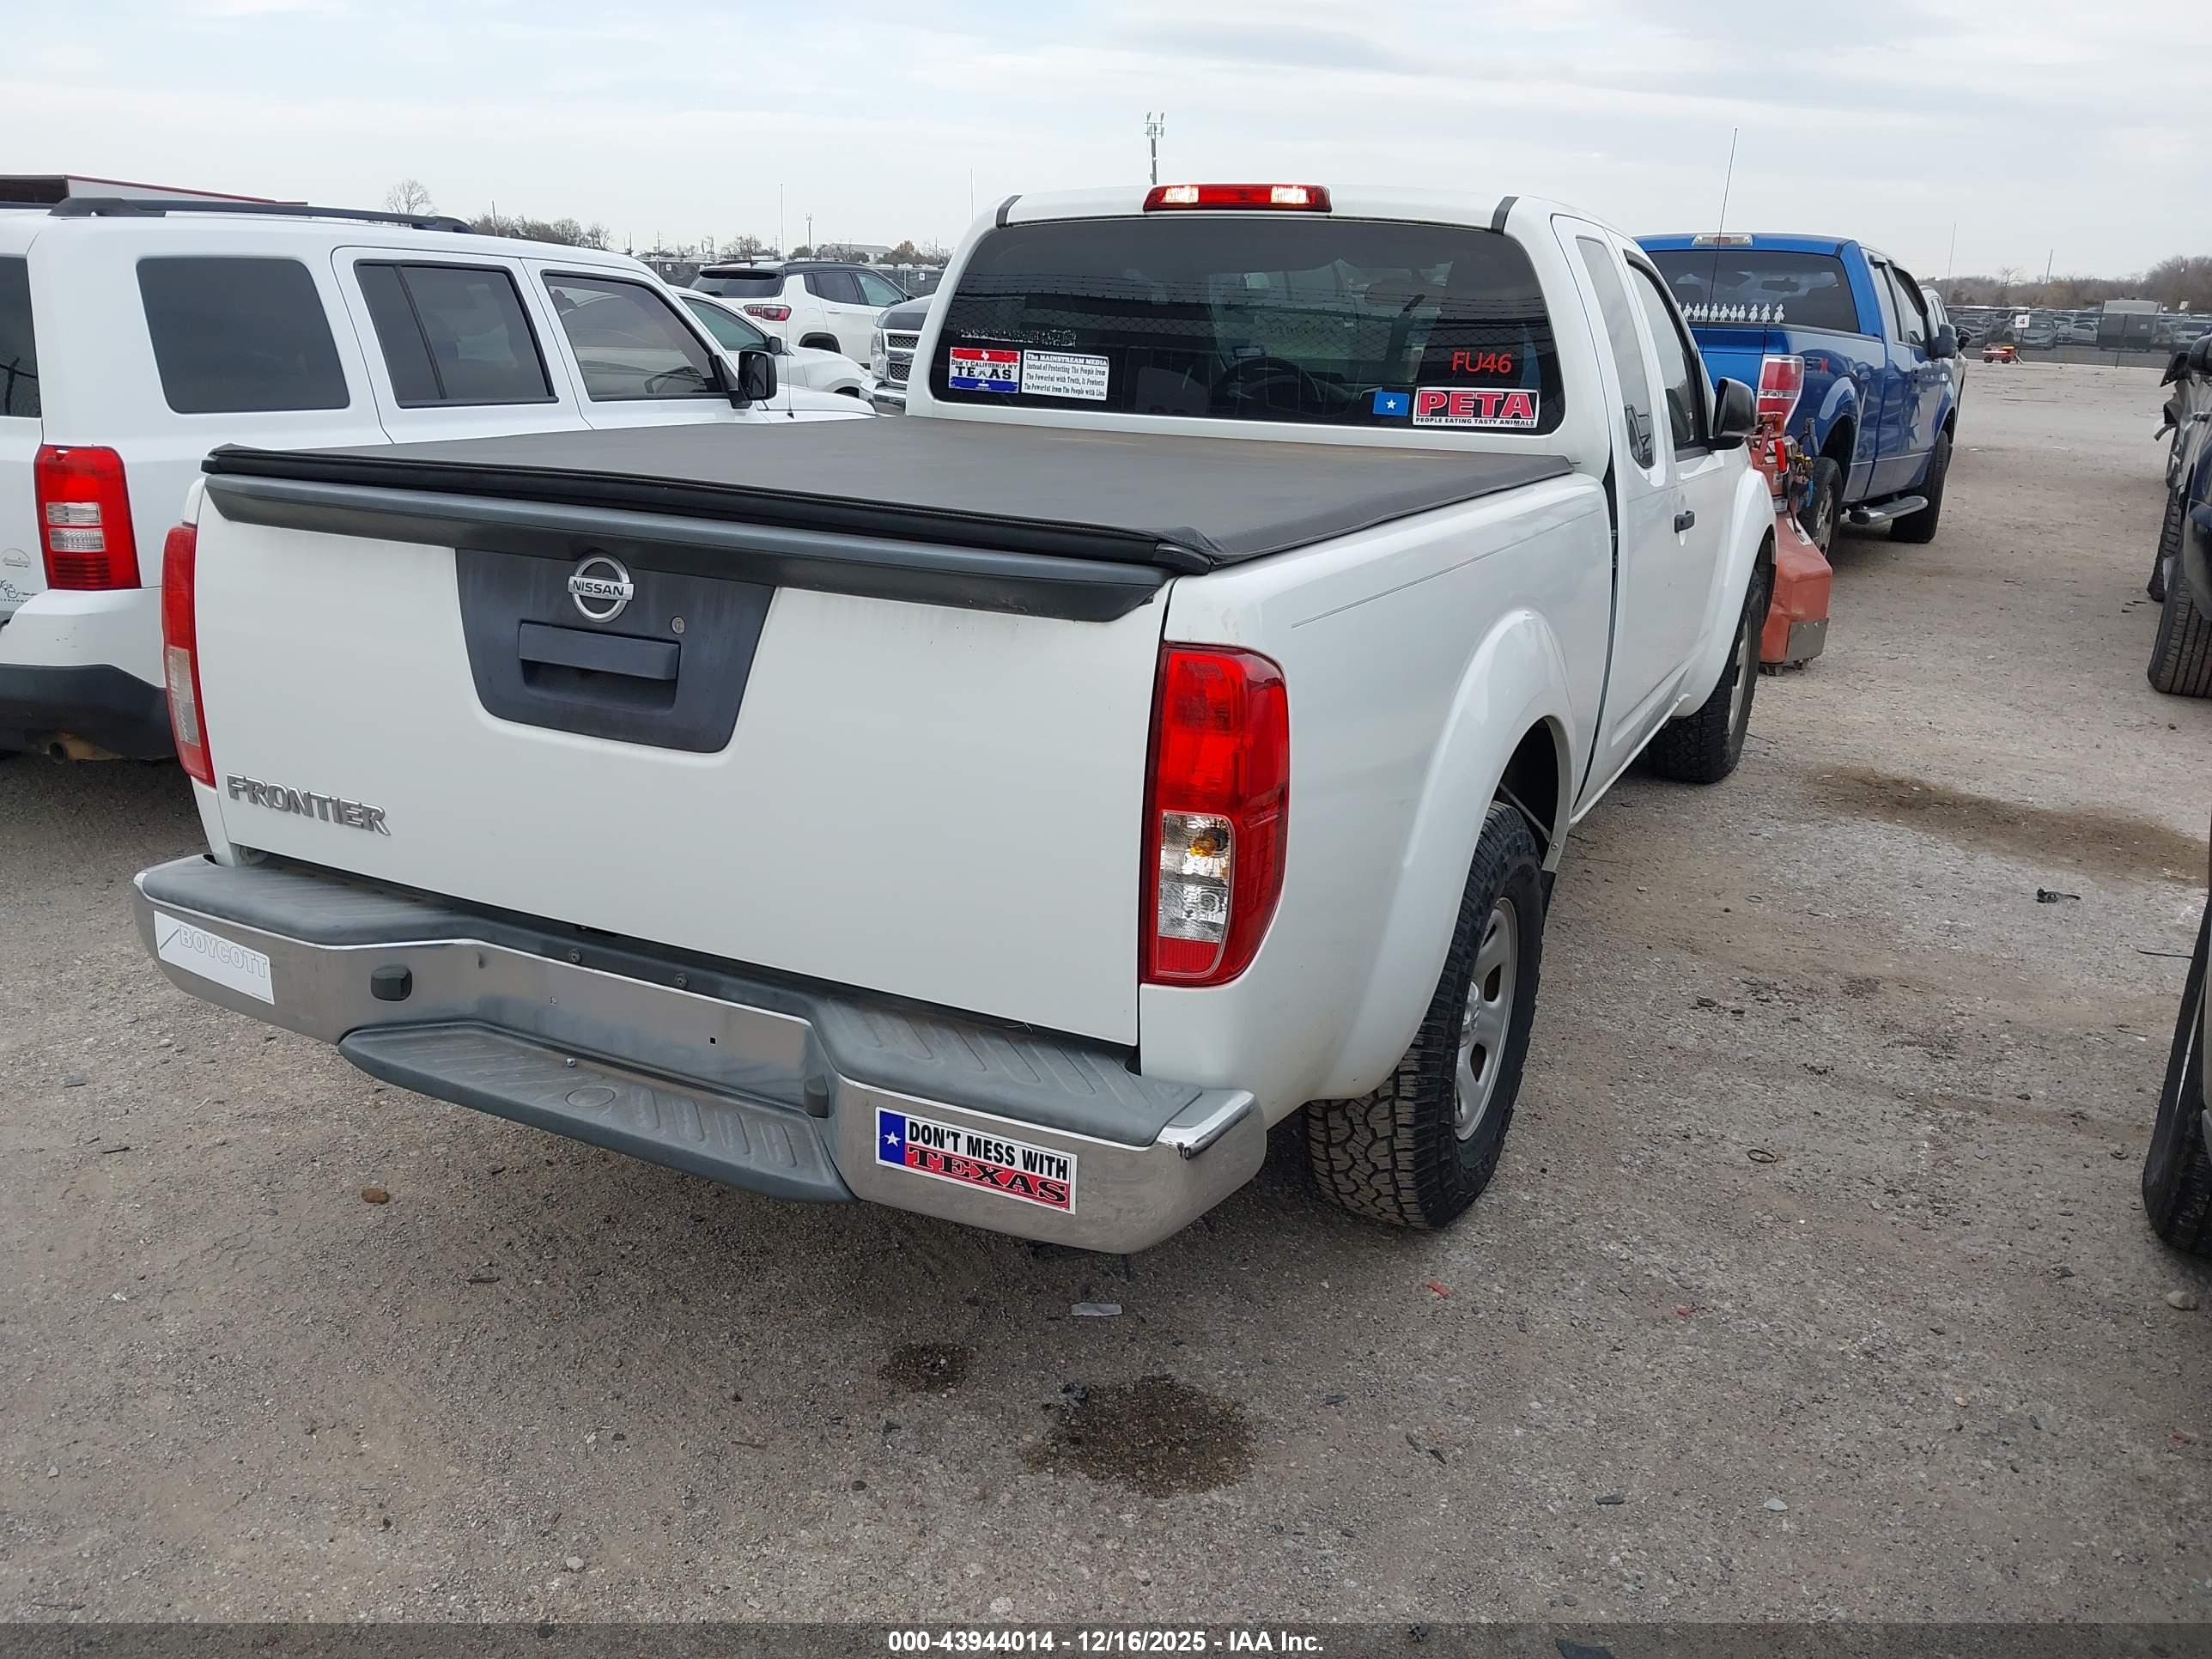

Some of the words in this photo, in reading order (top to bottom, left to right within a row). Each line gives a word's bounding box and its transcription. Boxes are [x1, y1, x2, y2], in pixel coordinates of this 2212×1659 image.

[1039, 355, 1085, 364] MAINSTREAM
[1048, 363, 1070, 374] Protecting
[1080, 367, 1094, 376] People
[1095, 368, 1105, 376] from
[1452, 351, 1512, 374] FU46
[955, 366, 1012, 380] TEXAS
[1035, 373, 1054, 382] Powerful
[1087, 378, 1105, 386] Protects
[1032, 383, 1050, 392] Powerful
[1071, 387, 1084, 396] People
[1418, 391, 1534, 418] PETA
[573, 580, 624, 597] NISSAN
[227, 772, 392, 836] FRONTIER
[179, 924, 268, 979] BOYCOTT
[908, 1121, 961, 1152] DON'T
[966, 1136, 1016, 1167] MESS
[1022, 1148, 1068, 1182] WITH
[908, 1146, 1067, 1203] TEXAS
